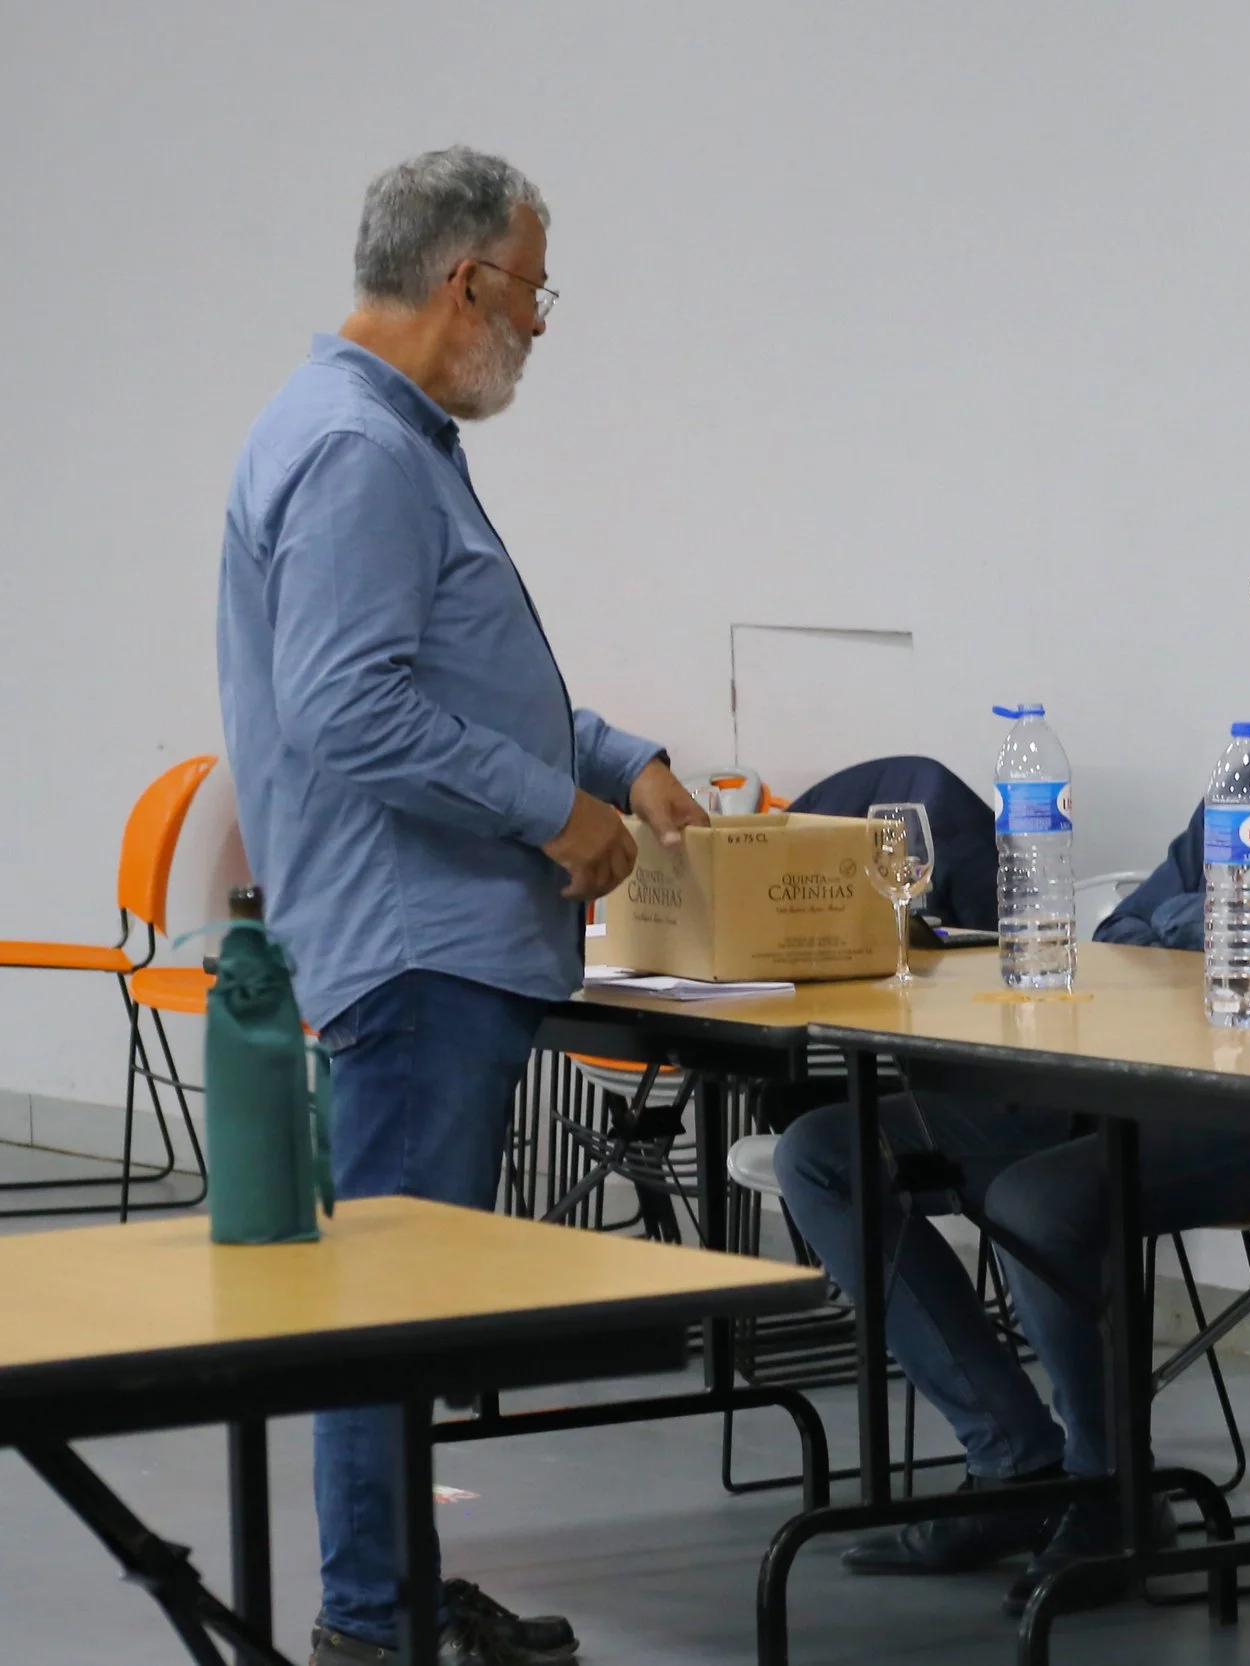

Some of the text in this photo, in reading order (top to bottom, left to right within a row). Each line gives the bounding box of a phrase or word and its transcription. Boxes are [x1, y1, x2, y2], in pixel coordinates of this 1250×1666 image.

[727, 834, 733, 843] 6
[744, 833, 754, 842] 75
[756, 832, 768, 842] CL
[782, 874, 827, 886] QUINTA
[768, 884, 853, 901] CAPINHAS
